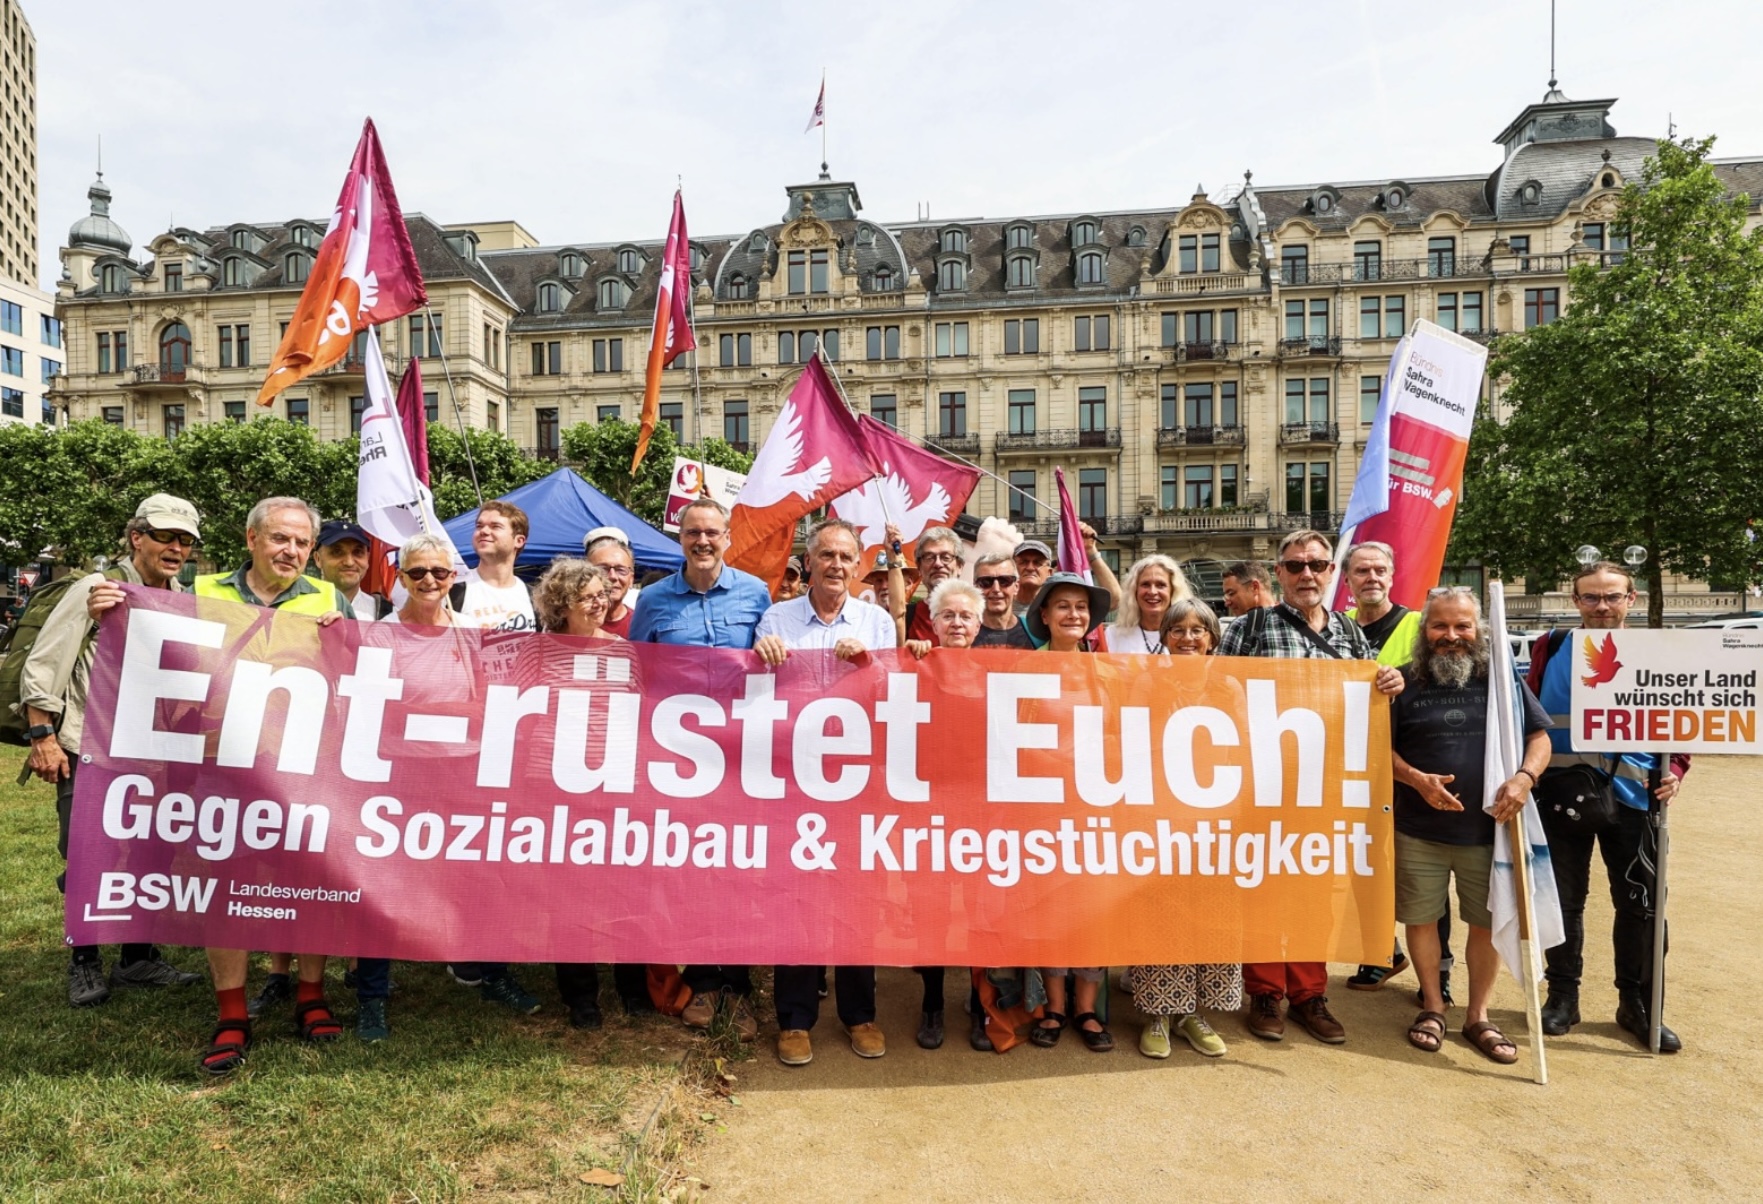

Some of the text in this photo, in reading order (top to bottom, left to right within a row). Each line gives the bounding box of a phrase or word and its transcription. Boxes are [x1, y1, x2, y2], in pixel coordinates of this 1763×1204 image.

[1410, 350, 1444, 377] Bündnis
[1406, 366, 1433, 387] Sahra
[1402, 481, 1433, 500] BSW.
[1636, 669, 1756, 687] Unser Land
[109, 608, 1371, 809] Ent-rüstet Euch!
[1614, 689, 1756, 706] wünscht sich
[1583, 709, 1756, 742] FRIEDEN
[102, 774, 1374, 888] Gegen Sozialabbau & Kriegstüchtigkeit
[97, 872, 361, 913] BSW Landesverband
[227, 901, 297, 920] Hessen
